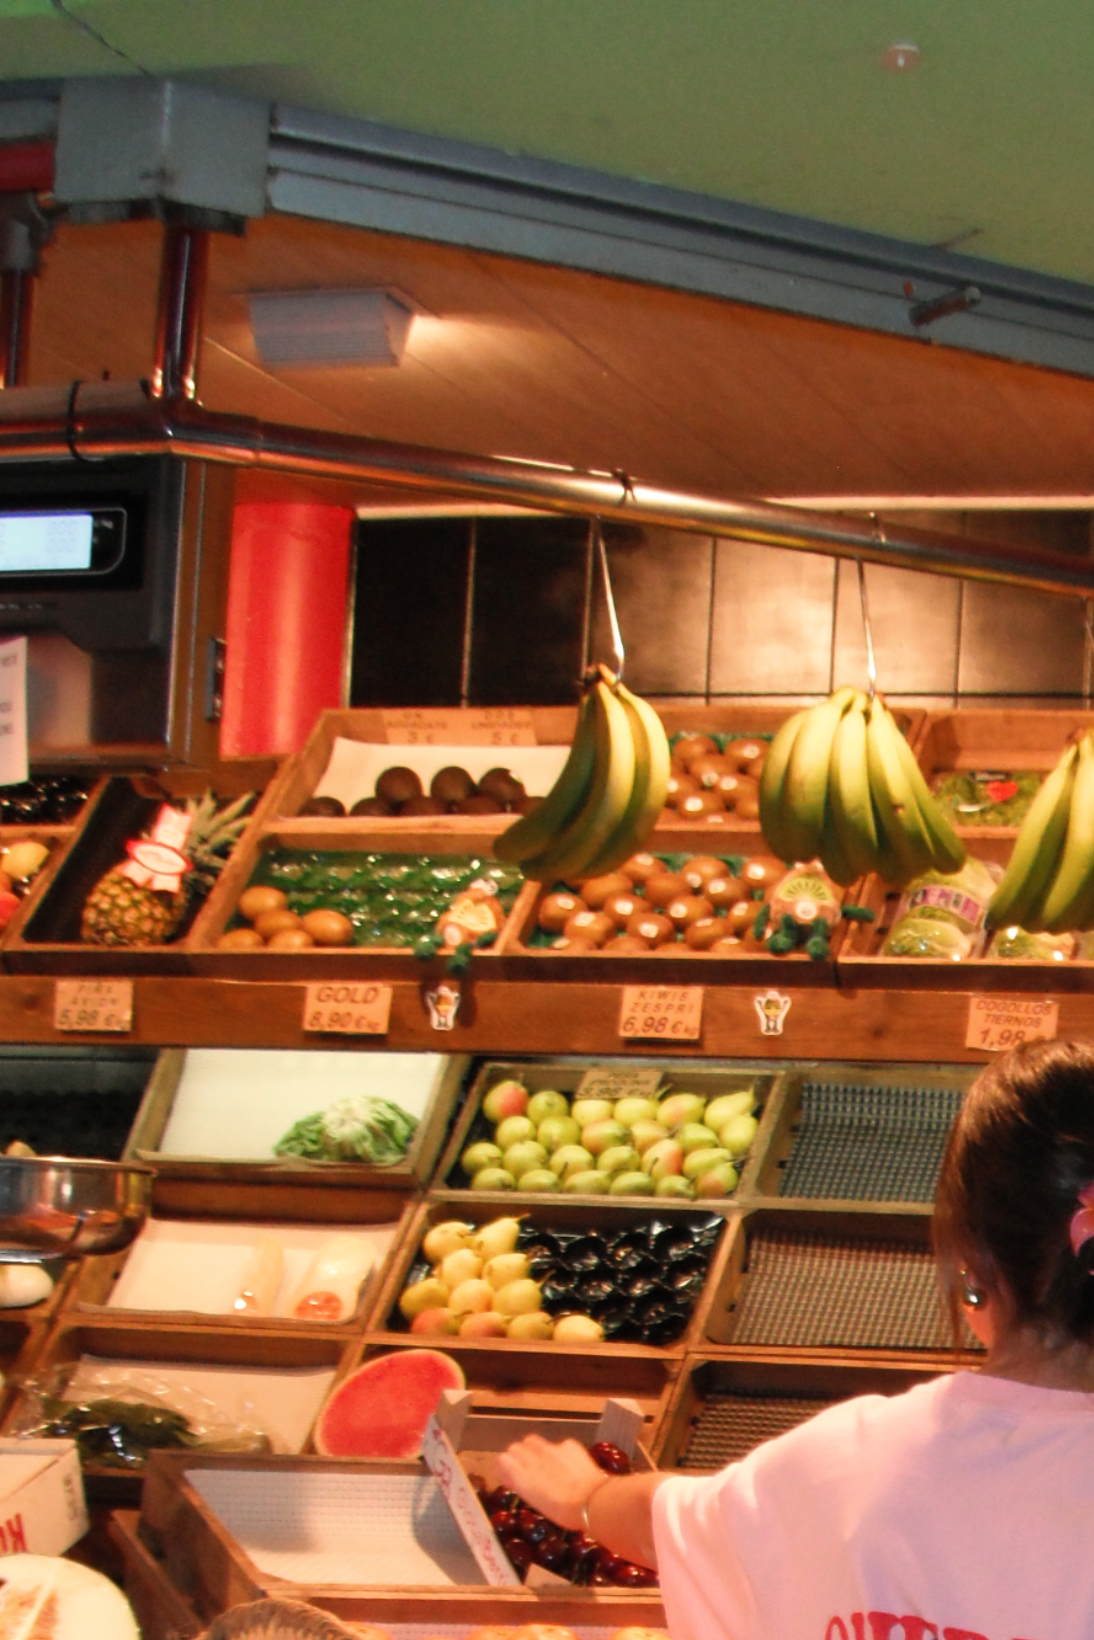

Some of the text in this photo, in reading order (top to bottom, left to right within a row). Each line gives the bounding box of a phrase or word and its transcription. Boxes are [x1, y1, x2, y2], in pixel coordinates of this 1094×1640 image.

[317, 985, 379, 1005] GOLD
[629, 1001, 695, 1015] ZESPRI
[622, 1015, 670, 1037] 6,98
[984, 1013, 1042, 1028] TIERNOS
